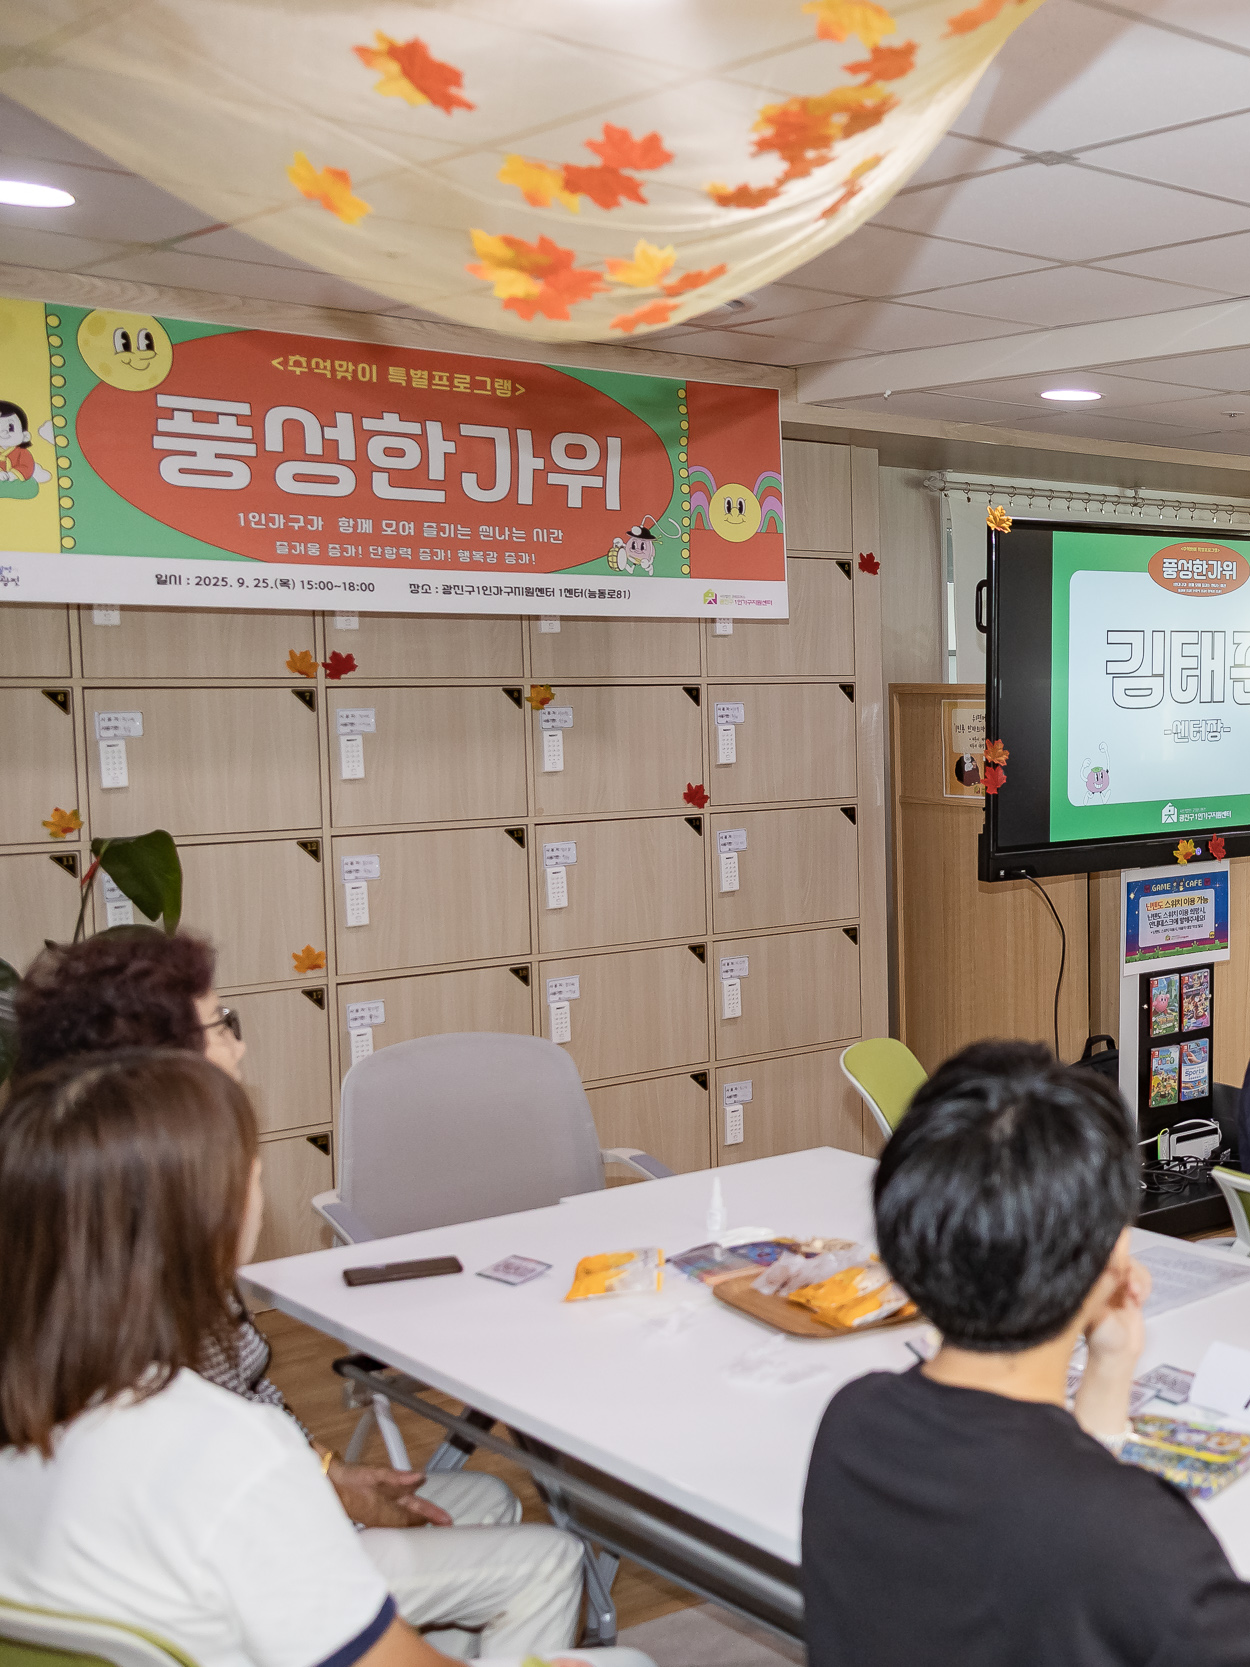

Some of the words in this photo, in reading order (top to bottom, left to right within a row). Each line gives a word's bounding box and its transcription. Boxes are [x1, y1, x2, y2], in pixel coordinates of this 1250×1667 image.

[271, 354, 378, 383] <추석맞이
[387, 365, 526, 398] 특별프로그램>
[152, 392, 622, 511] 풍성한가위
[237, 512, 324, 531] 1인가구가
[338, 516, 373, 534] 함께
[381, 519, 415, 536] 모여
[422, 521, 472, 540] 즐기는
[533, 528, 564, 544] 시간
[275, 540, 321, 557] 즐거움
[328, 543, 363, 558] 증가!
[368, 545, 412, 560] 단합력
[418, 548, 451, 562] 증가!
[457, 549, 498, 564] 행복감
[504, 552, 536, 565] 증가!
[1162, 558, 1237, 580] 풍성한가위
[155, 573, 182, 586] 일시
[194, 576, 233, 588] 2025.
[237, 577, 249, 588] 9.
[253, 577, 296, 590] 25.(목)
[300, 579, 375, 592] 15:00~18:00
[409, 583, 432, 595] 장소
[441, 584, 555, 598] 광진구1인가구지원센터
[304, 692, 310, 700] 7
[1163, 718, 1231, 743] -센터장-
[306, 842, 317, 850] 12
[63, 856, 74, 866] 11
[1151, 882, 1171, 892] GAME
[1185, 879, 1203, 888] CAFE
[1145, 900, 1164, 911] 닌텐도
[1164, 898, 1183, 909] 스위치
[1183, 897, 1196, 906] 이용
[1196, 895, 1209, 905] 가능
[312, 991, 322, 999] 17
